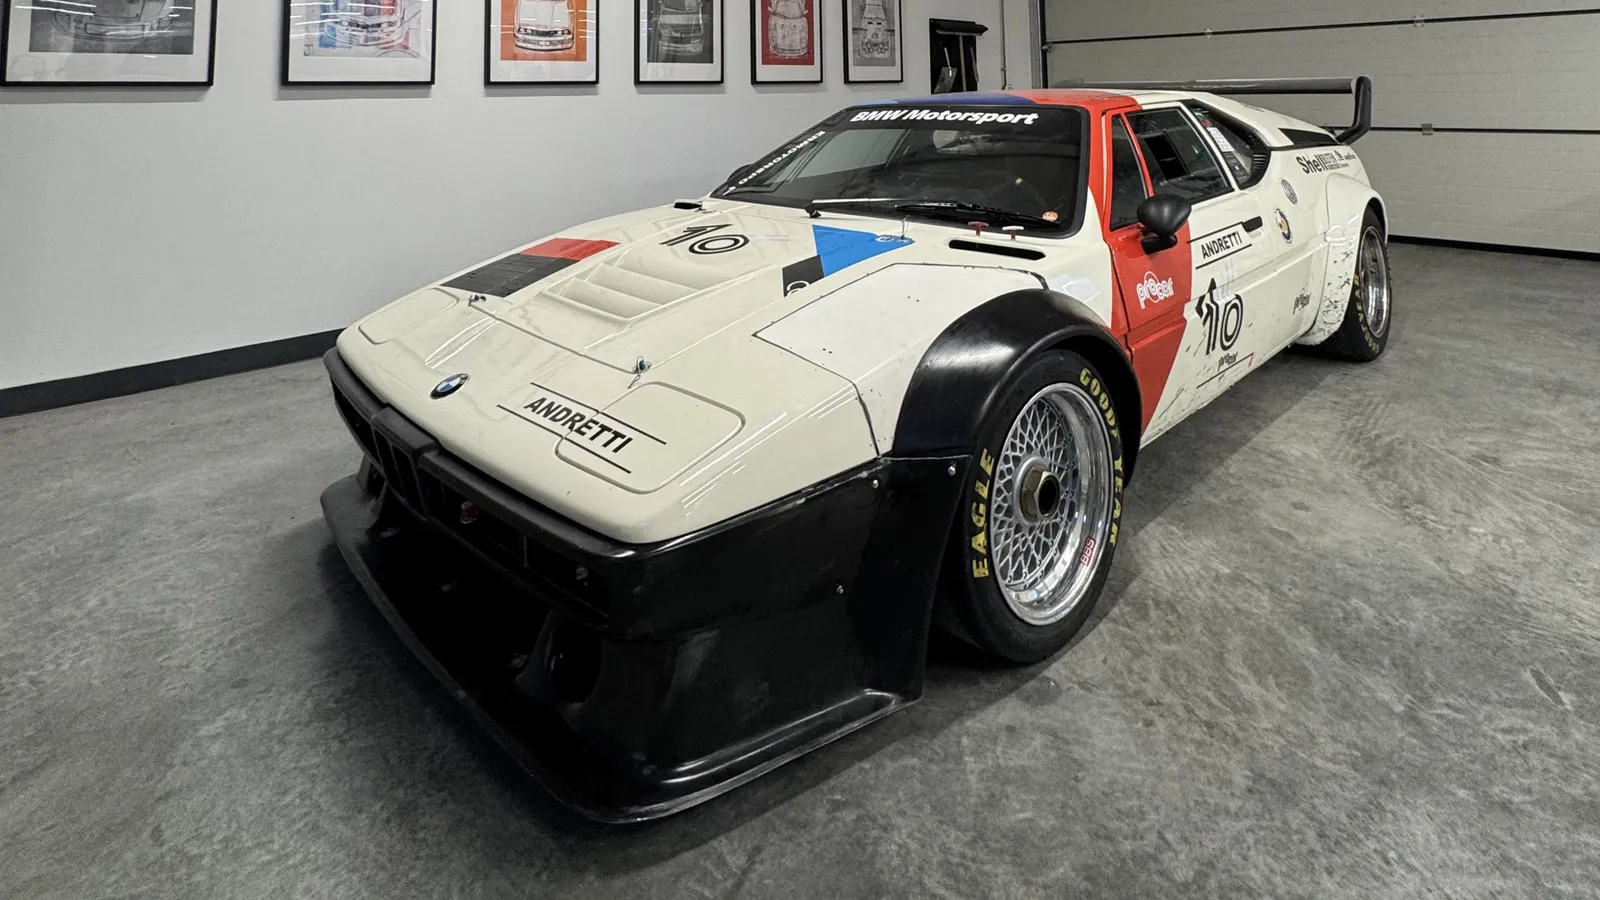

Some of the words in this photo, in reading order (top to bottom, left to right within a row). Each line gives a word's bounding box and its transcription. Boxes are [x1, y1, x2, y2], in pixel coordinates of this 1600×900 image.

[850, 110, 908, 122] BMW
[903, 109, 1039, 125] Motorsport
[1296, 154, 1328, 174] Shell
[658, 223, 750, 255] 10
[1201, 231, 1243, 259] ANDRETTI
[1195, 278, 1244, 356] 10
[523, 397, 633, 454] ANDRETTI
[971, 448, 995, 578] EAGLE
[1079, 537, 1096, 566] BBS
